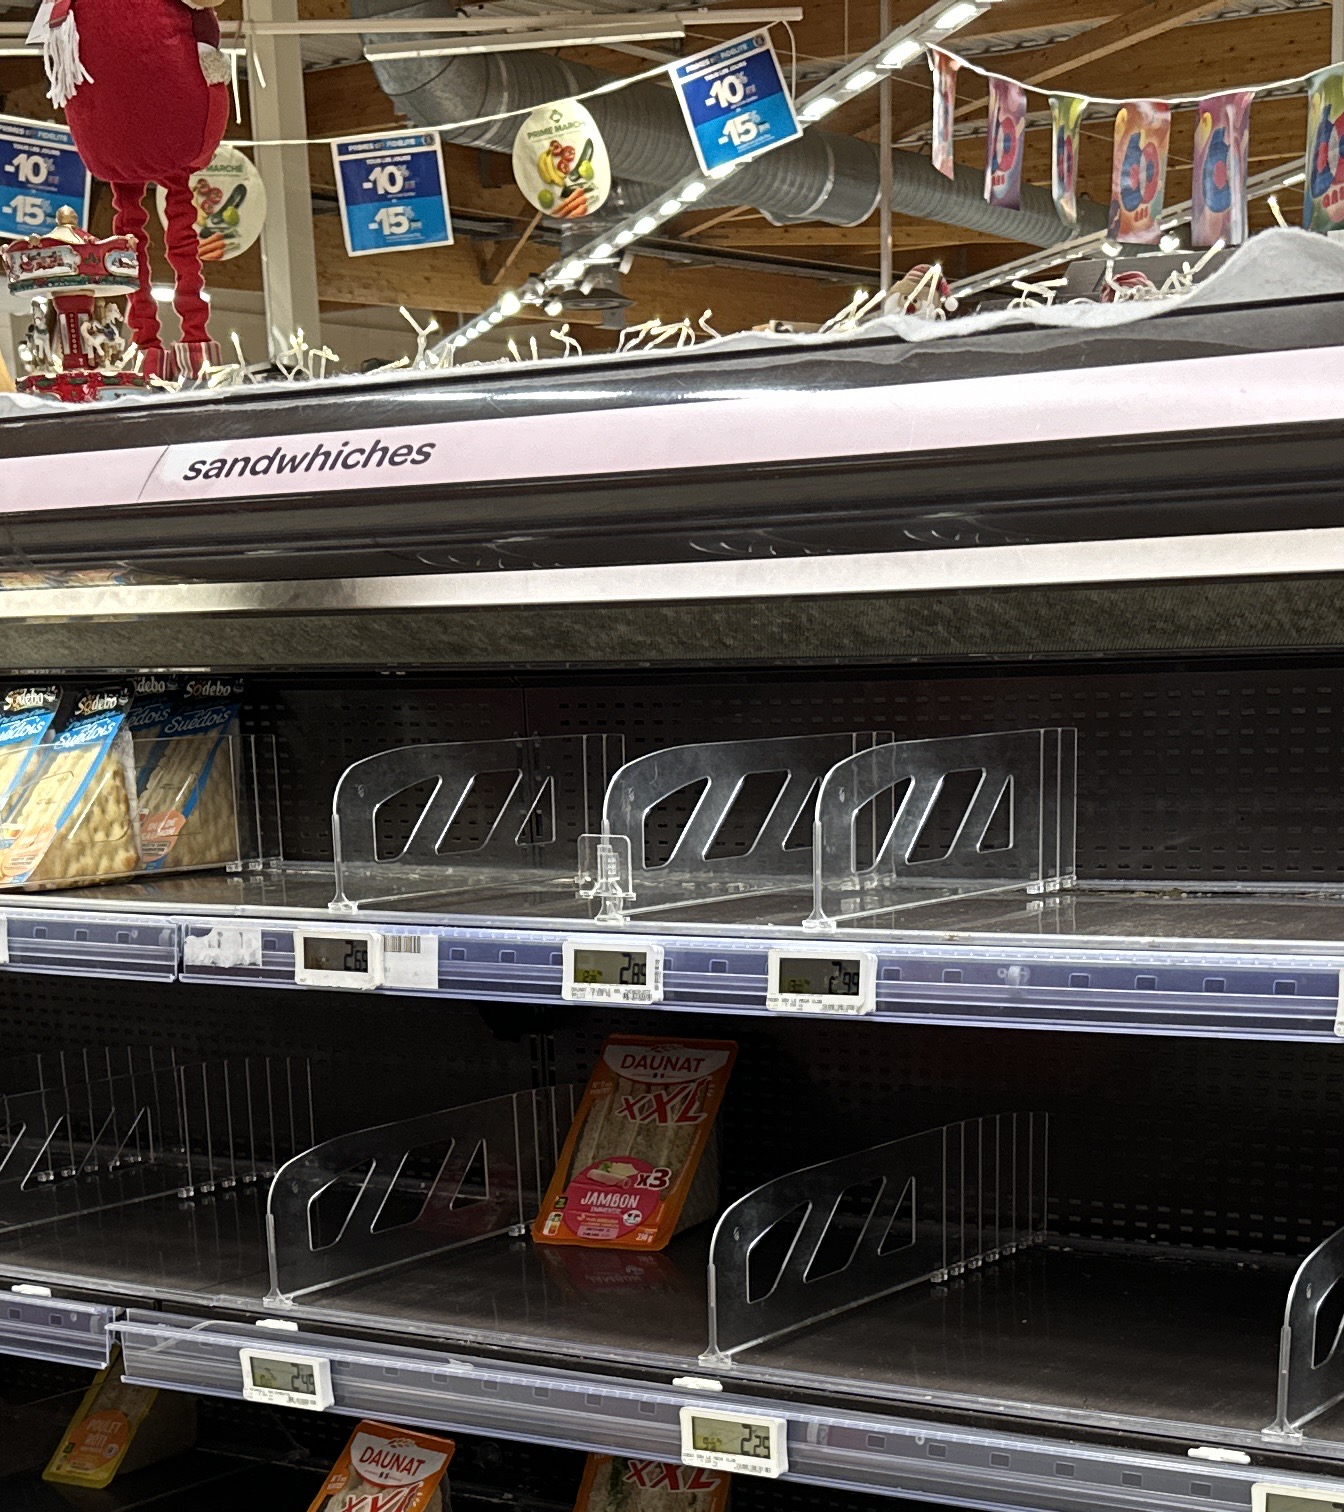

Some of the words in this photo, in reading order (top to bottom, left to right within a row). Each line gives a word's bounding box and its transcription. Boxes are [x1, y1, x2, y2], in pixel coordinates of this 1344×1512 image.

[182, 438, 437, 482] sandwhiches
[135, 677, 166, 694] debo
[620, 1053, 706, 1074] DAUNAT
[614, 1076, 713, 1126] XXL
[580, 1190, 641, 1210] JAMBON
[86, 1418, 123, 1437] POULET
[358, 1445, 426, 1478] DAUNAT
